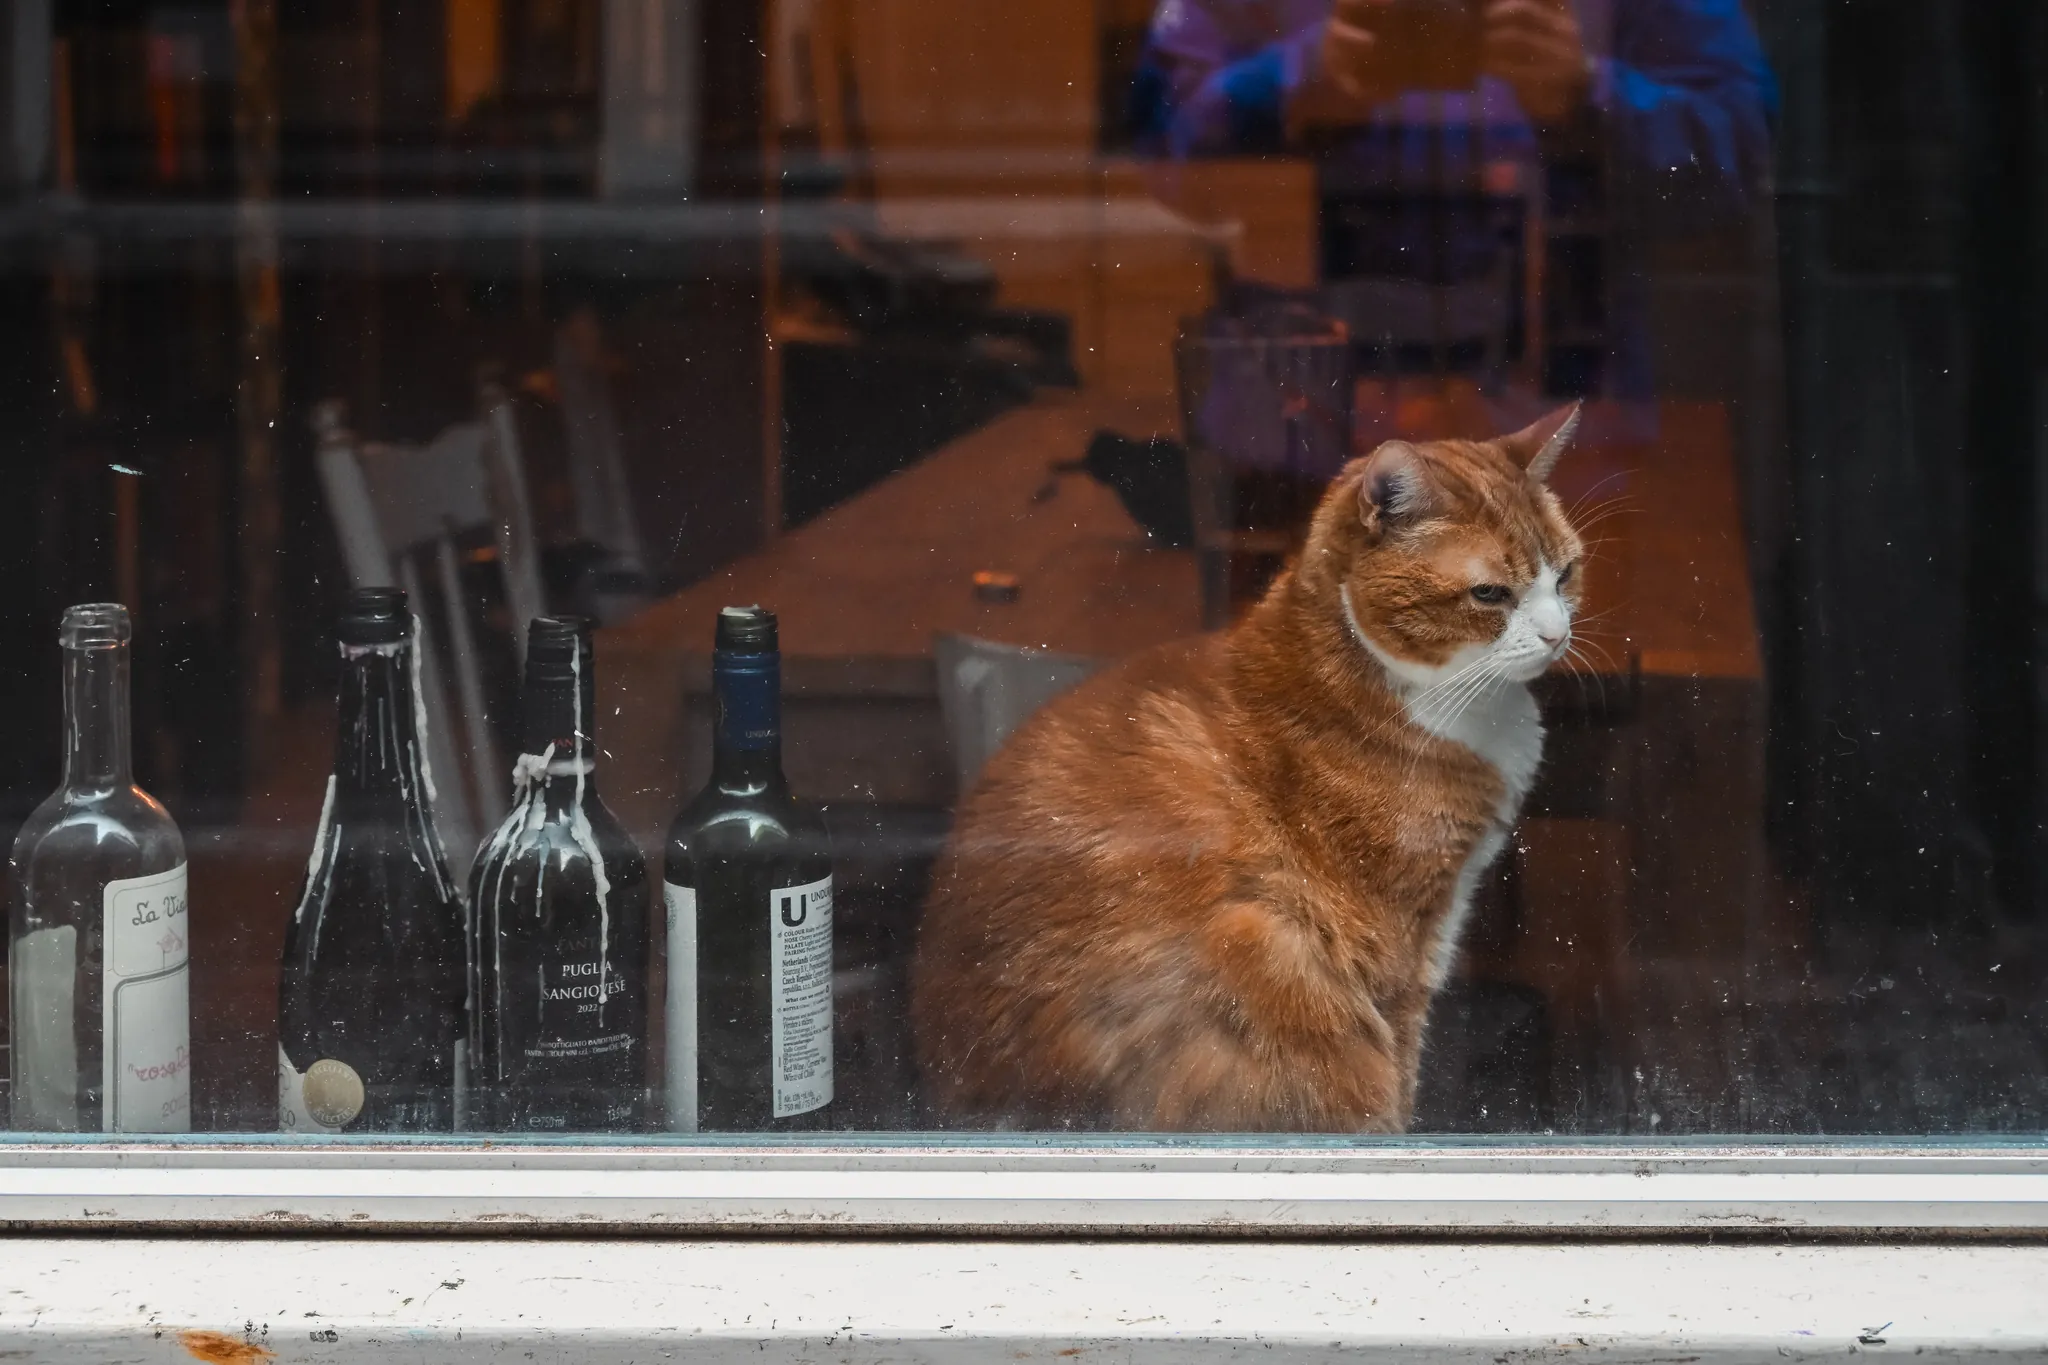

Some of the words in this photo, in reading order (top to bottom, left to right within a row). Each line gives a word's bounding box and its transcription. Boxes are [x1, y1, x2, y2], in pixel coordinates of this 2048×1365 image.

[132, 900, 160, 926] La
[781, 894, 806, 927] U
[784, 929, 805, 937] COLOUR
[784, 942, 803, 950] PALATE
[784, 948, 805, 956] PAIRING
[577, 1003, 598, 1013] 2022
